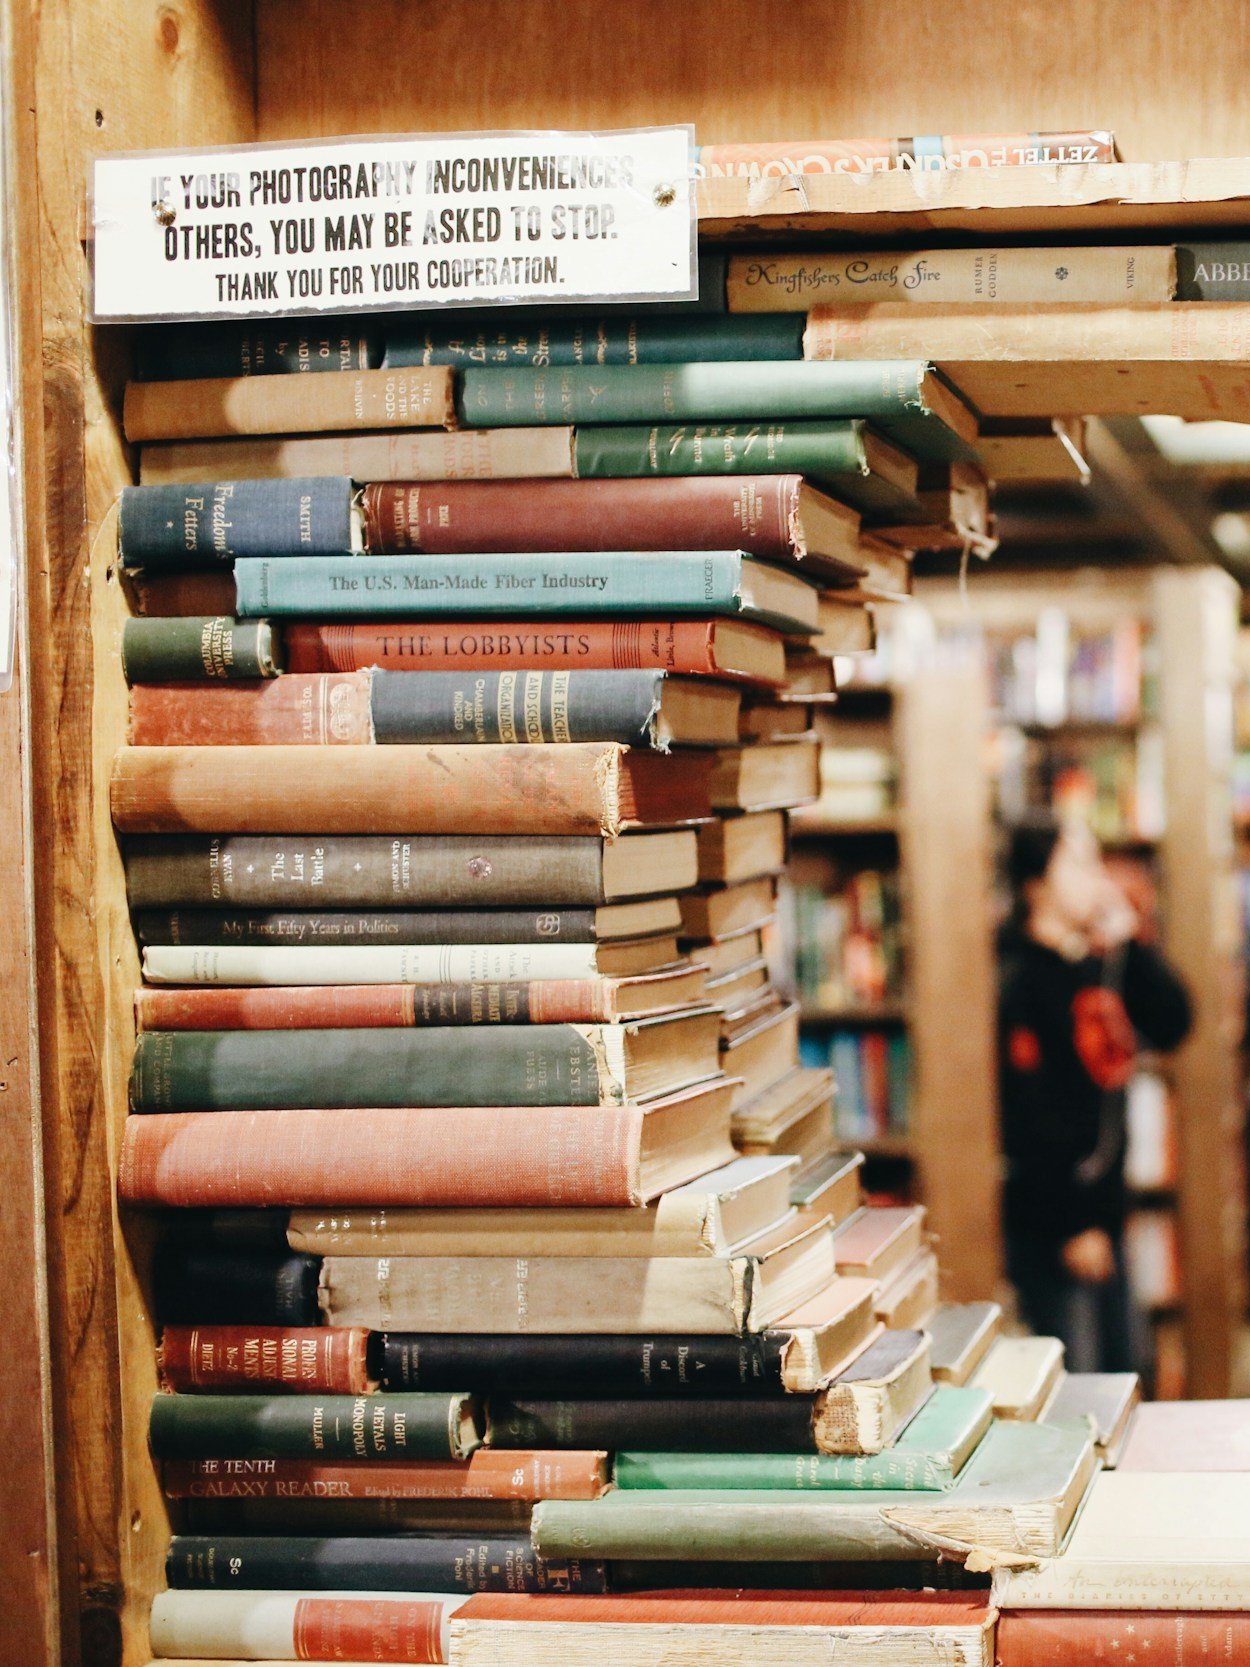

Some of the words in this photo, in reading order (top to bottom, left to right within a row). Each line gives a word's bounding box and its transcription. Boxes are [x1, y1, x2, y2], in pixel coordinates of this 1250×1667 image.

[1013, 146, 1100, 166] ZETTEL
[151, 175, 172, 208] IF
[181, 172, 242, 211] YOUR
[249, 160, 417, 207] PHOTOGRAPHY
[425, 153, 636, 197] INCONVENIENCES
[164, 222, 262, 262] OTHERS,
[270, 217, 318, 256] YOU
[324, 213, 376, 252] MAY
[385, 211, 414, 248] BE
[421, 206, 502, 246] ASKED
[510, 204, 542, 241] TO
[550, 202, 619, 241] STOP.
[215, 270, 280, 303] THANK
[286, 268, 323, 298] YOU
[329, 265, 364, 296] FOR
[371, 263, 420, 293] YOUR
[426, 255, 566, 290] COOPERATION.
[745, 259, 841, 294] Kingfishers
[844, 258, 899, 287] Catch
[903, 259, 941, 290] Fire
[974, 256, 984, 294] RUMER
[988, 252, 998, 299] GODDEN
[1126, 256, 1135, 290] VIKING
[185, 496, 204, 552] Fetters
[299, 495, 312, 543] SMITH
[329, 575, 360, 591] The
[364, 574, 398, 591] U.S.
[403, 574, 488, 591] Man-Made
[495, 573, 539, 589] Fiber
[540, 573, 609, 591] Industry
[704, 558, 714, 601] PRAEGER
[202, 621, 215, 677] COLUMBIA
[222, 630, 233, 666] PRESS
[375, 635, 434, 657] THE
[443, 634, 591, 656] LOBBYISTS
[553, 675, 568, 697] THE
[453, 690, 464, 731] KINDRED
[463, 700, 473, 723] AND
[223, 852, 234, 883] RYAN
[271, 851, 285, 882] The
[290, 851, 304, 882] Last
[310, 847, 324, 887] Battle
[401, 842, 411, 892] SCHUSTER
[222, 919, 245, 939] My
[248, 919, 274, 935] First
[276, 918, 307, 939] Fifty
[310, 920, 341, 935] Years
[343, 920, 356, 935] in
[358, 919, 400, 935] Politics
[201, 1343, 214, 1372] DIETZ
[244, 1337, 260, 1380] MENTS
[282, 1337, 298, 1381] SIONAL
[311, 1406, 325, 1450] MULLER
[351, 1396, 369, 1458] MONOPOLY
[373, 1405, 388, 1452] METALS
[393, 1411, 407, 1447] LIGHT
[224, 1459, 276, 1475] TENTH
[189, 1480, 270, 1498] GALAXY
[275, 1480, 354, 1498] READER
[401, 1485, 459, 1499] FREDERIK
[459, 1486, 494, 1499] POHL
[229, 1556, 242, 1577] Sc
[478, 1545, 489, 1578] Edited
[505, 1549, 516, 1591] FICTION
[515, 1546, 526, 1592] SCIENCE
[1223, 1625, 1233, 1660] Adams
